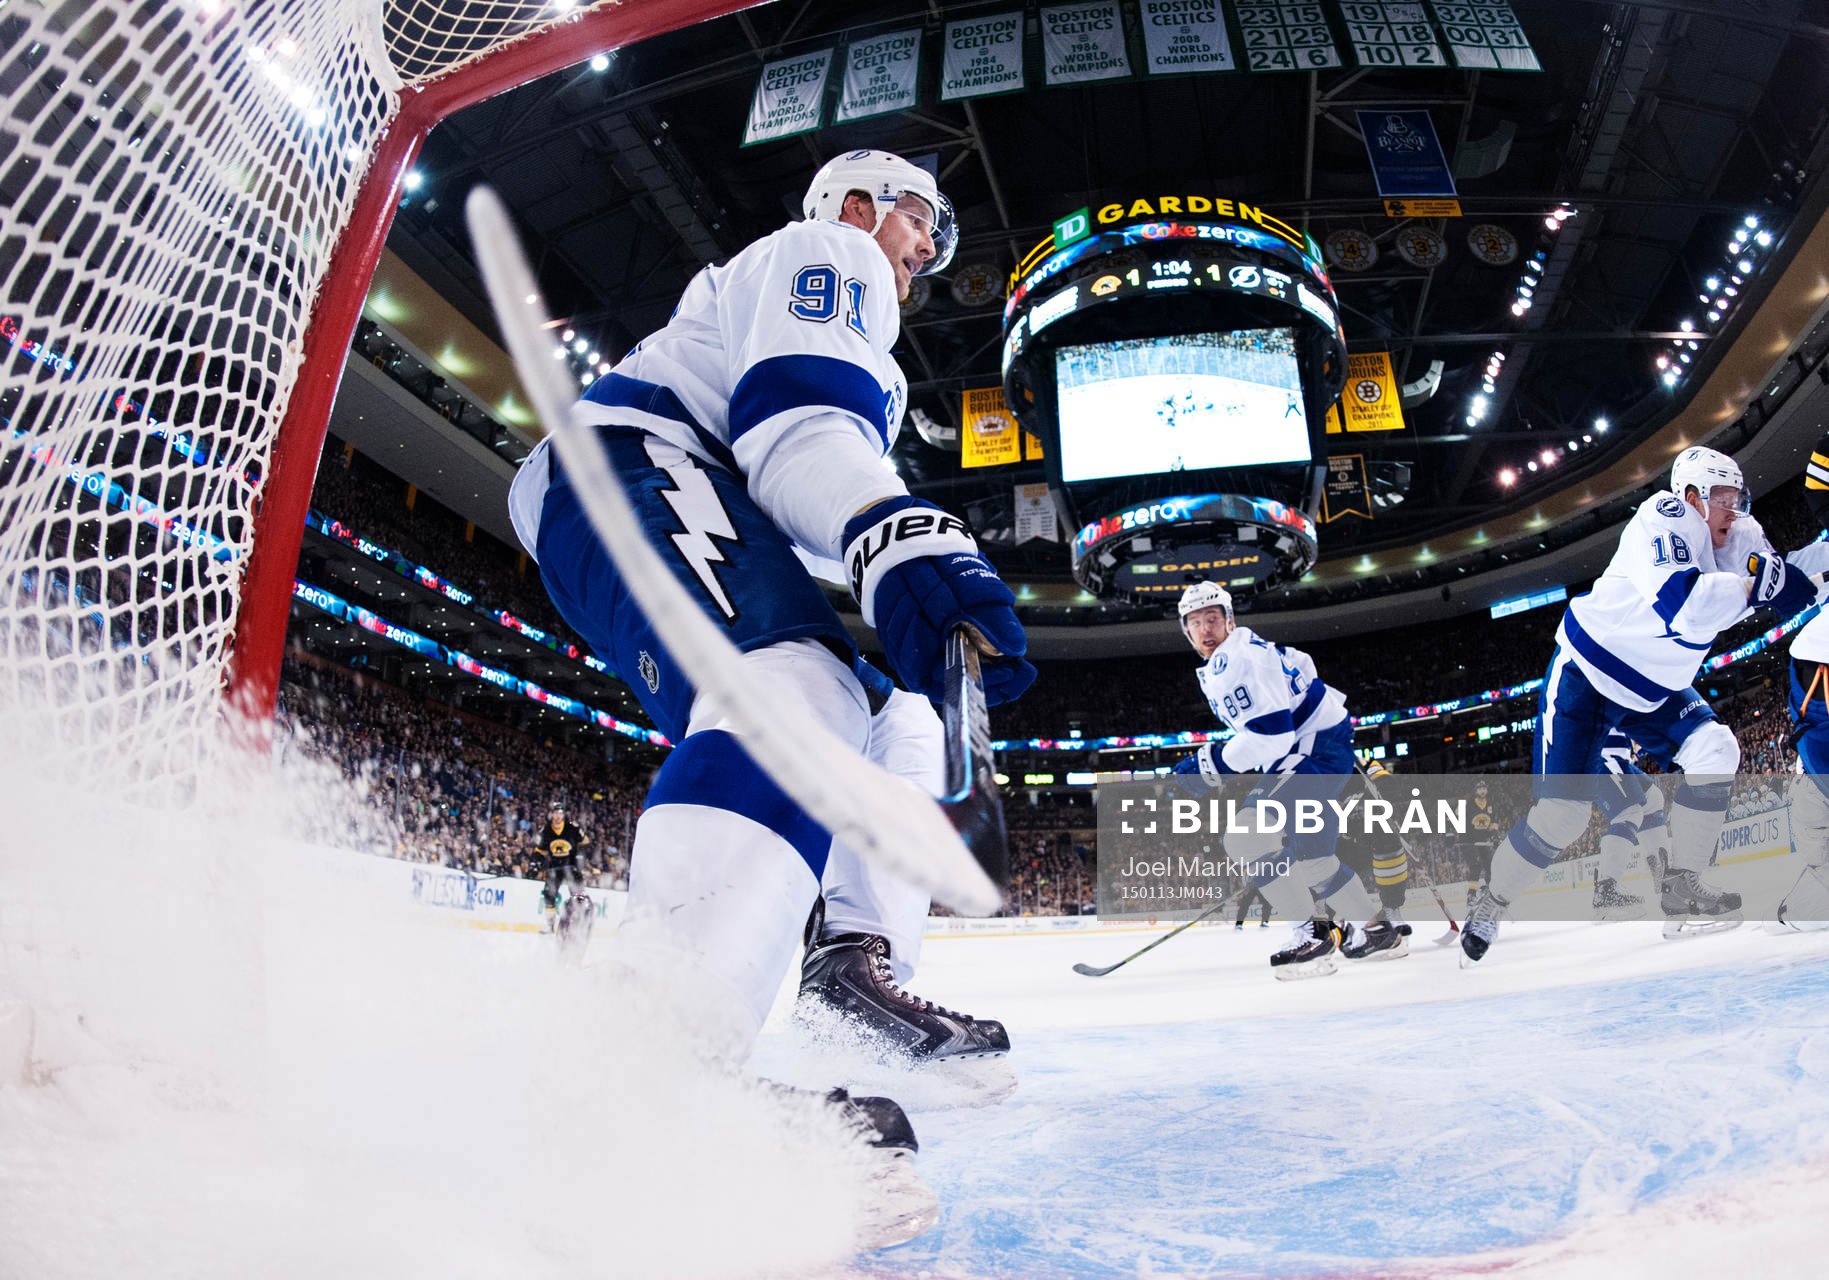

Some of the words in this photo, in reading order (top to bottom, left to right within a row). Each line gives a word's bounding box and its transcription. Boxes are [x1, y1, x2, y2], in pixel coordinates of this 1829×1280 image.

[1047, 7, 1114, 24] BOSTON
[1148, 0, 1216, 14] BOSTON
[1345, 5, 1379, 21] 19
[1438, 6, 1475, 23] 32
[1478, 8, 1515, 24] 35
[1152, 11, 1216, 26] CELTICS
[1239, 8, 1279, 25] 23
[1287, 7, 1321, 23] 15
[952, 19, 1017, 39] BOSTON
[1051, 18, 1113, 35] CELTICS
[1352, 25, 1385, 41] 17
[1396, 25, 1431, 41] 18
[953, 31, 1014, 50] CELTICS
[1172, 35, 1201, 45] 2008
[1248, 28, 1283, 46] 21
[1291, 27, 1330, 45] 25
[1447, 27, 1484, 44] 00
[1490, 29, 1526, 45] 31
[853, 37, 915, 59] BOSTON
[1071, 42, 1099, 53] 1986
[1167, 44, 1211, 54] WORLD
[1360, 46, 1395, 63] 10
[1413, 46, 1435, 64] 2
[854, 49, 911, 71] CELTICS
[970, 56, 996, 67] 1984
[1064, 51, 1109, 64] WORLD
[1156, 53, 1225, 65] CHAMPIONS
[1251, 51, 1291, 70] 24
[1307, 49, 1329, 67] 6
[766, 57, 826, 81] BOSTON
[962, 64, 1005, 78] WORLD
[1051, 58, 1124, 75] CHAMPIONS
[766, 69, 821, 91] CELTICS
[868, 74, 891, 86] 1981
[947, 71, 1018, 89] CHAMPIONS
[858, 82, 899, 98] WORLD
[777, 96, 799, 108] 1976
[843, 90, 911, 111] CHAMPIONS
[768, 104, 805, 119] WORLD
[752, 109, 815, 132] CHAMPIONS
[1056, 215, 1085, 241] TD
[1097, 195, 1262, 225] GARDEN
[1152, 261, 1192, 276] 1:04
[1206, 264, 1221, 281] 1
[1127, 269, 1140, 286] 1
[789, 264, 869, 344] 91
[1350, 354, 1385, 367] OSTON
[1350, 366, 1386, 378] RUINS
[970, 388, 1005, 403] BOSTO
[970, 400, 1007, 414] BRUIN
[1652, 532, 1693, 566] 18
[1161, 555, 1260, 572] GARDEN
[1223, 684, 1253, 720] 89
[1720, 817, 1779, 851] SUPERCUTS
